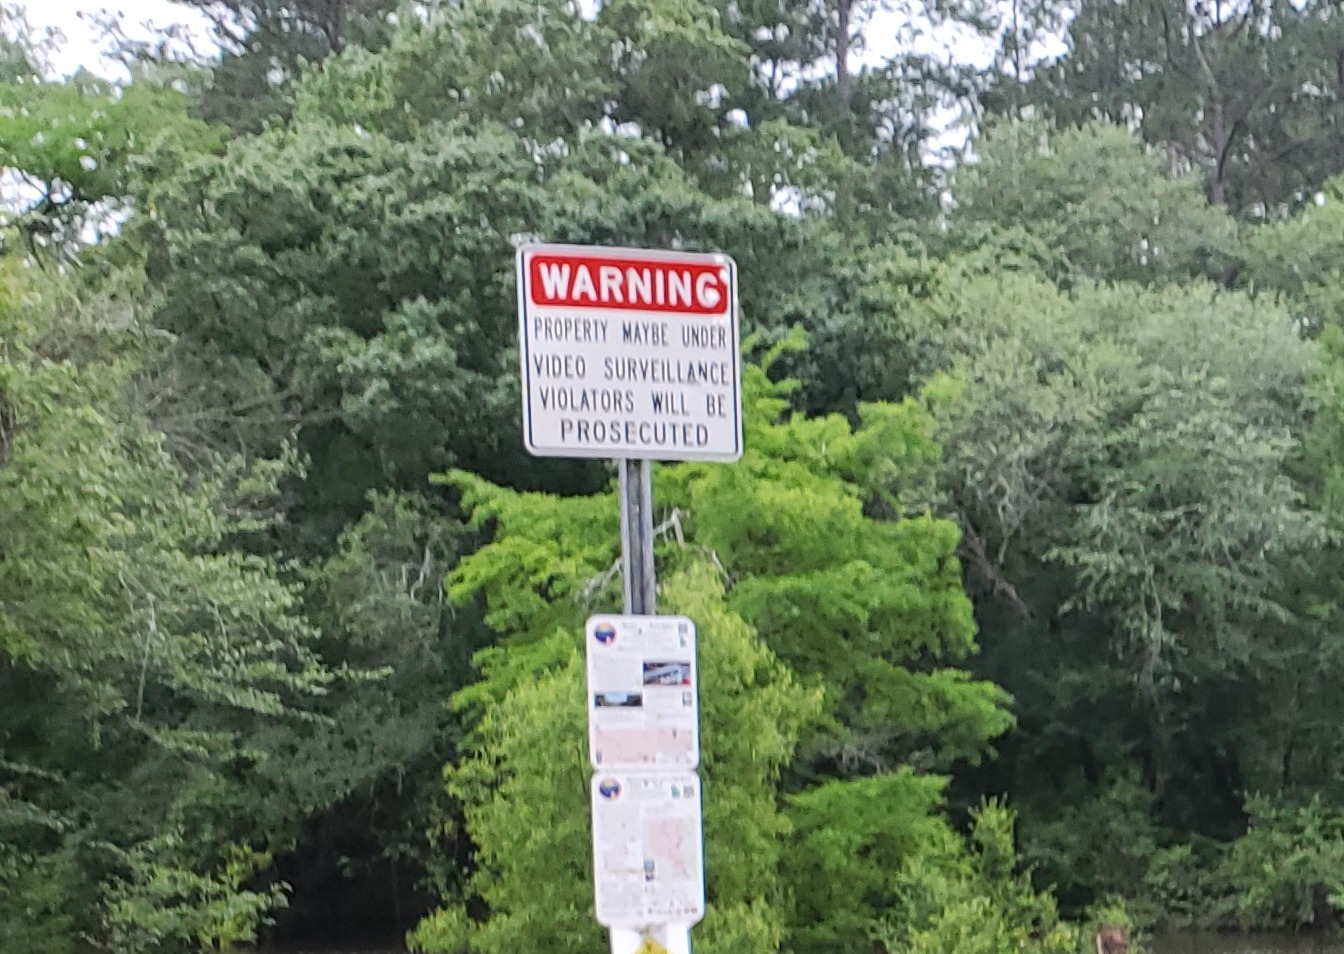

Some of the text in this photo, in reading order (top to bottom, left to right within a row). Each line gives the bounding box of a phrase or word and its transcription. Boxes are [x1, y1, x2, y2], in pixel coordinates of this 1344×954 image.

[538, 262, 721, 309] WARNING
[533, 316, 727, 349] PROPERTY MAYBE UNDER
[533, 353, 729, 386] VIDEO SURVEILLANCE
[539, 386, 727, 418] VIOLATORS WILL BE
[560, 419, 709, 446] PROSECUTED
